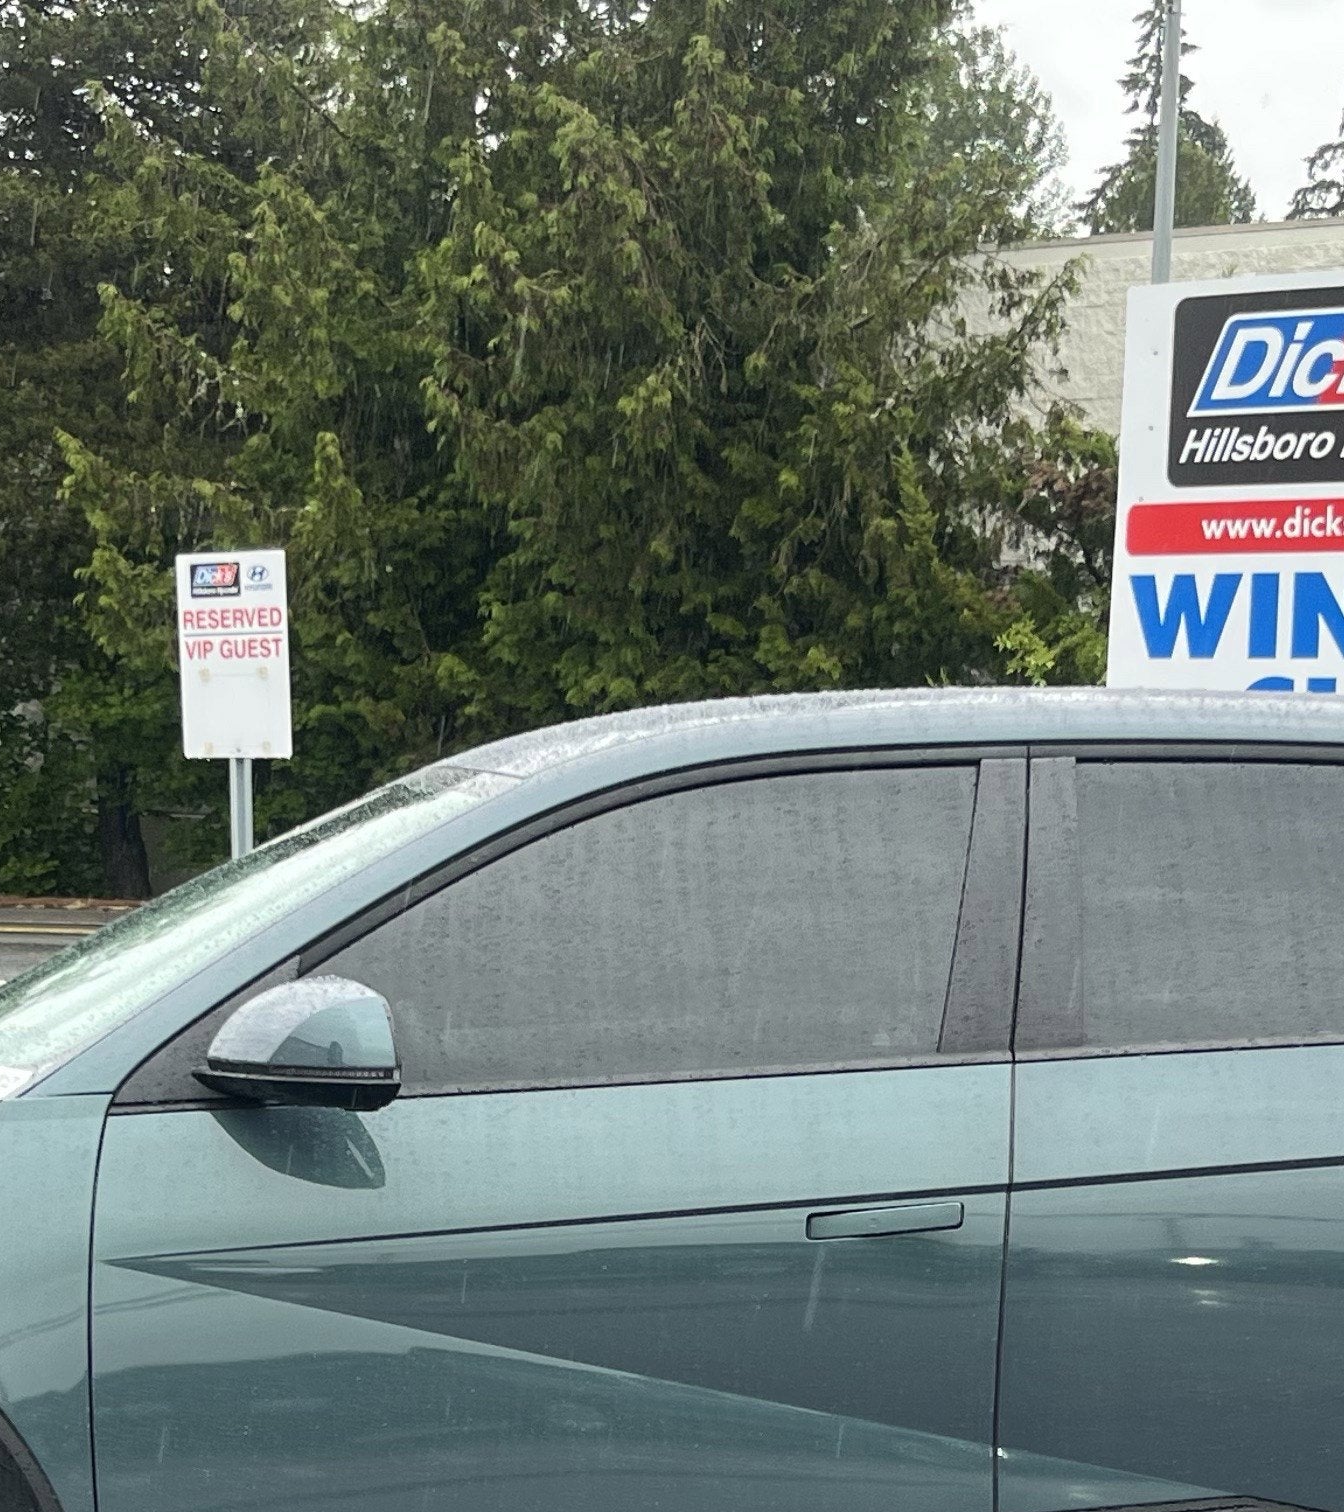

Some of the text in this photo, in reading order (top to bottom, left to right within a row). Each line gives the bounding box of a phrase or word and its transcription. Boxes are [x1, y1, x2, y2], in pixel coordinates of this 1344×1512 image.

[1178, 425, 1336, 465] Hillsboro
[183, 607, 282, 630] RESERVED
[185, 638, 283, 660] VIP GUEST
